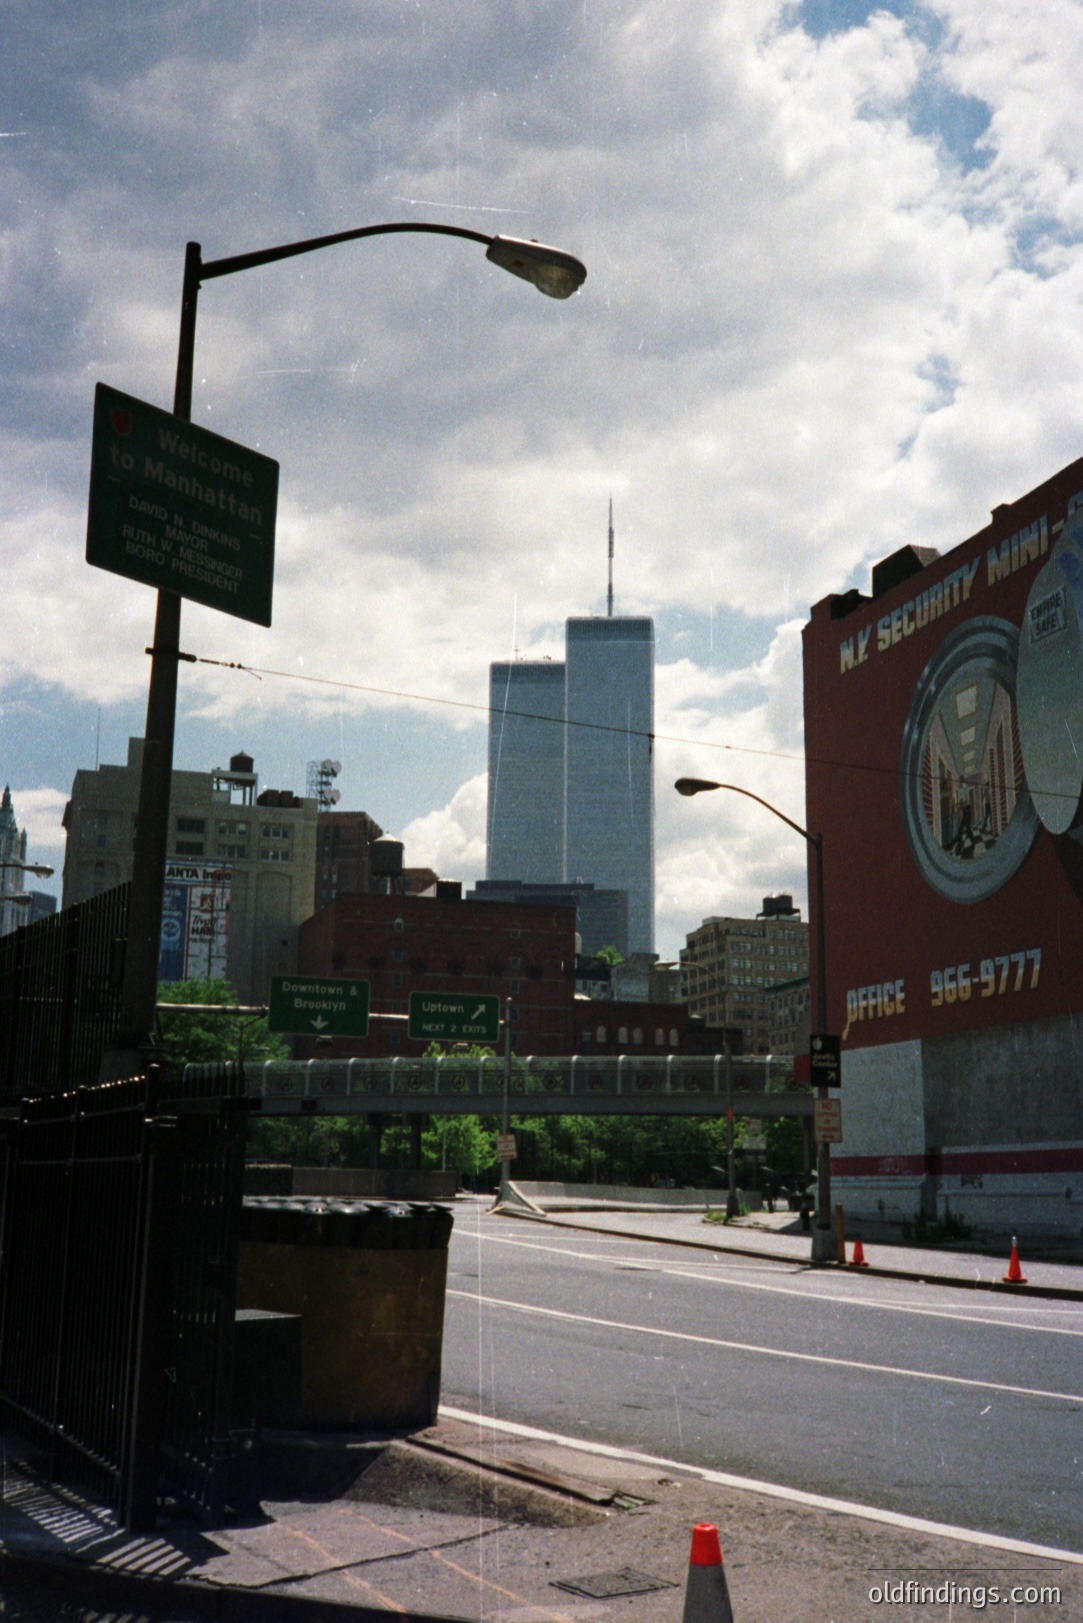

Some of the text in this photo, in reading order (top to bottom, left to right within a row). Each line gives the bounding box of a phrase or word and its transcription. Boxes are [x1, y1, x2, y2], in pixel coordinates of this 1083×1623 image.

[159, 428, 254, 488] Welcome
[110, 445, 262, 526] to Manhattan
[129, 495, 241, 551] DAVID N. DINKINS
[165, 525, 209, 553] MAYOR
[122, 524, 156, 548] RUTH
[180, 546, 243, 581] MESSINGER
[125, 542, 239, 593] BORO PRESIDENT
[877, 555, 981, 652] SECURITY
[282, 981, 358, 996] Downtown &
[294, 998, 346, 1011] Brooklyn
[422, 1002, 464, 1014] Uptown
[842, 948, 1042, 1040] OFFICE 966-9777
[422, 1023, 487, 1034] NEXT 2 EXITS
